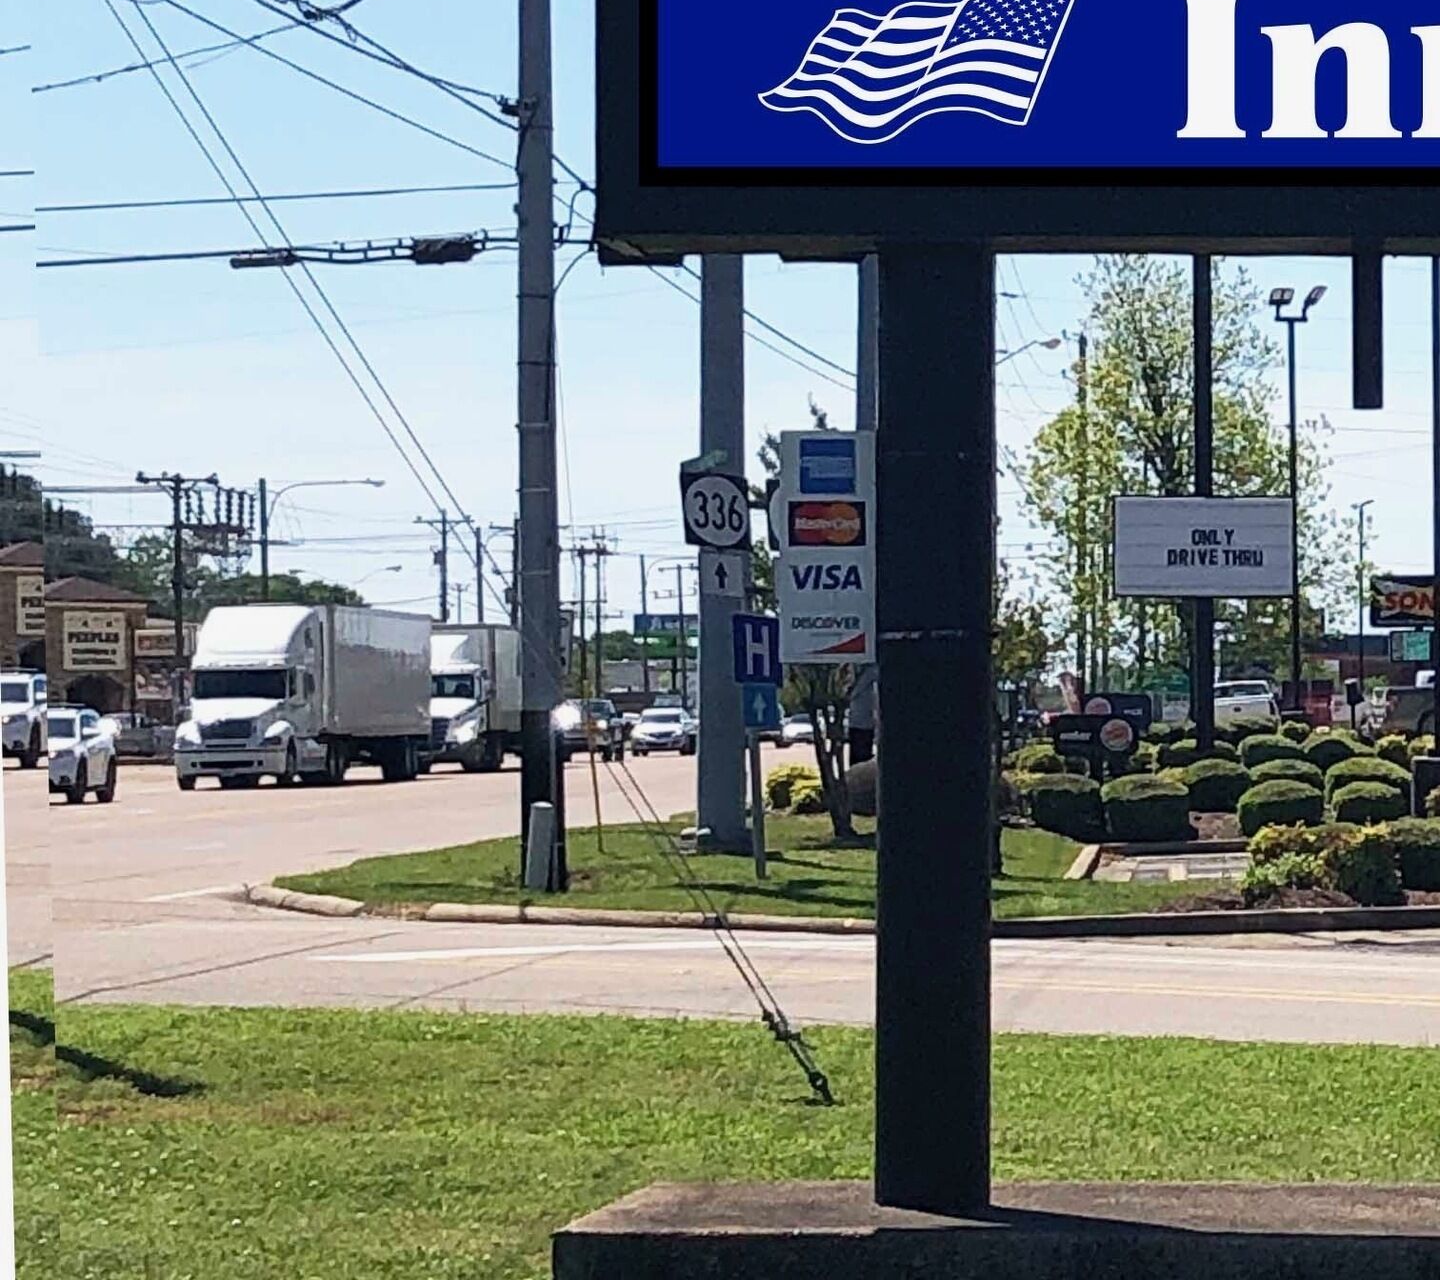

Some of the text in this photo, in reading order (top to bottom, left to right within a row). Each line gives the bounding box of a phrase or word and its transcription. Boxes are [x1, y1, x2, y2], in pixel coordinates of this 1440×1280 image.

[693, 491, 743, 532] 336
[1191, 529, 1235, 545] ONLY
[1167, 549, 1263, 567] DRIVE THRU
[789, 565, 863, 590] VISA
[791, 617, 861, 630] DISCOVER
[745, 622, 771, 677] H
